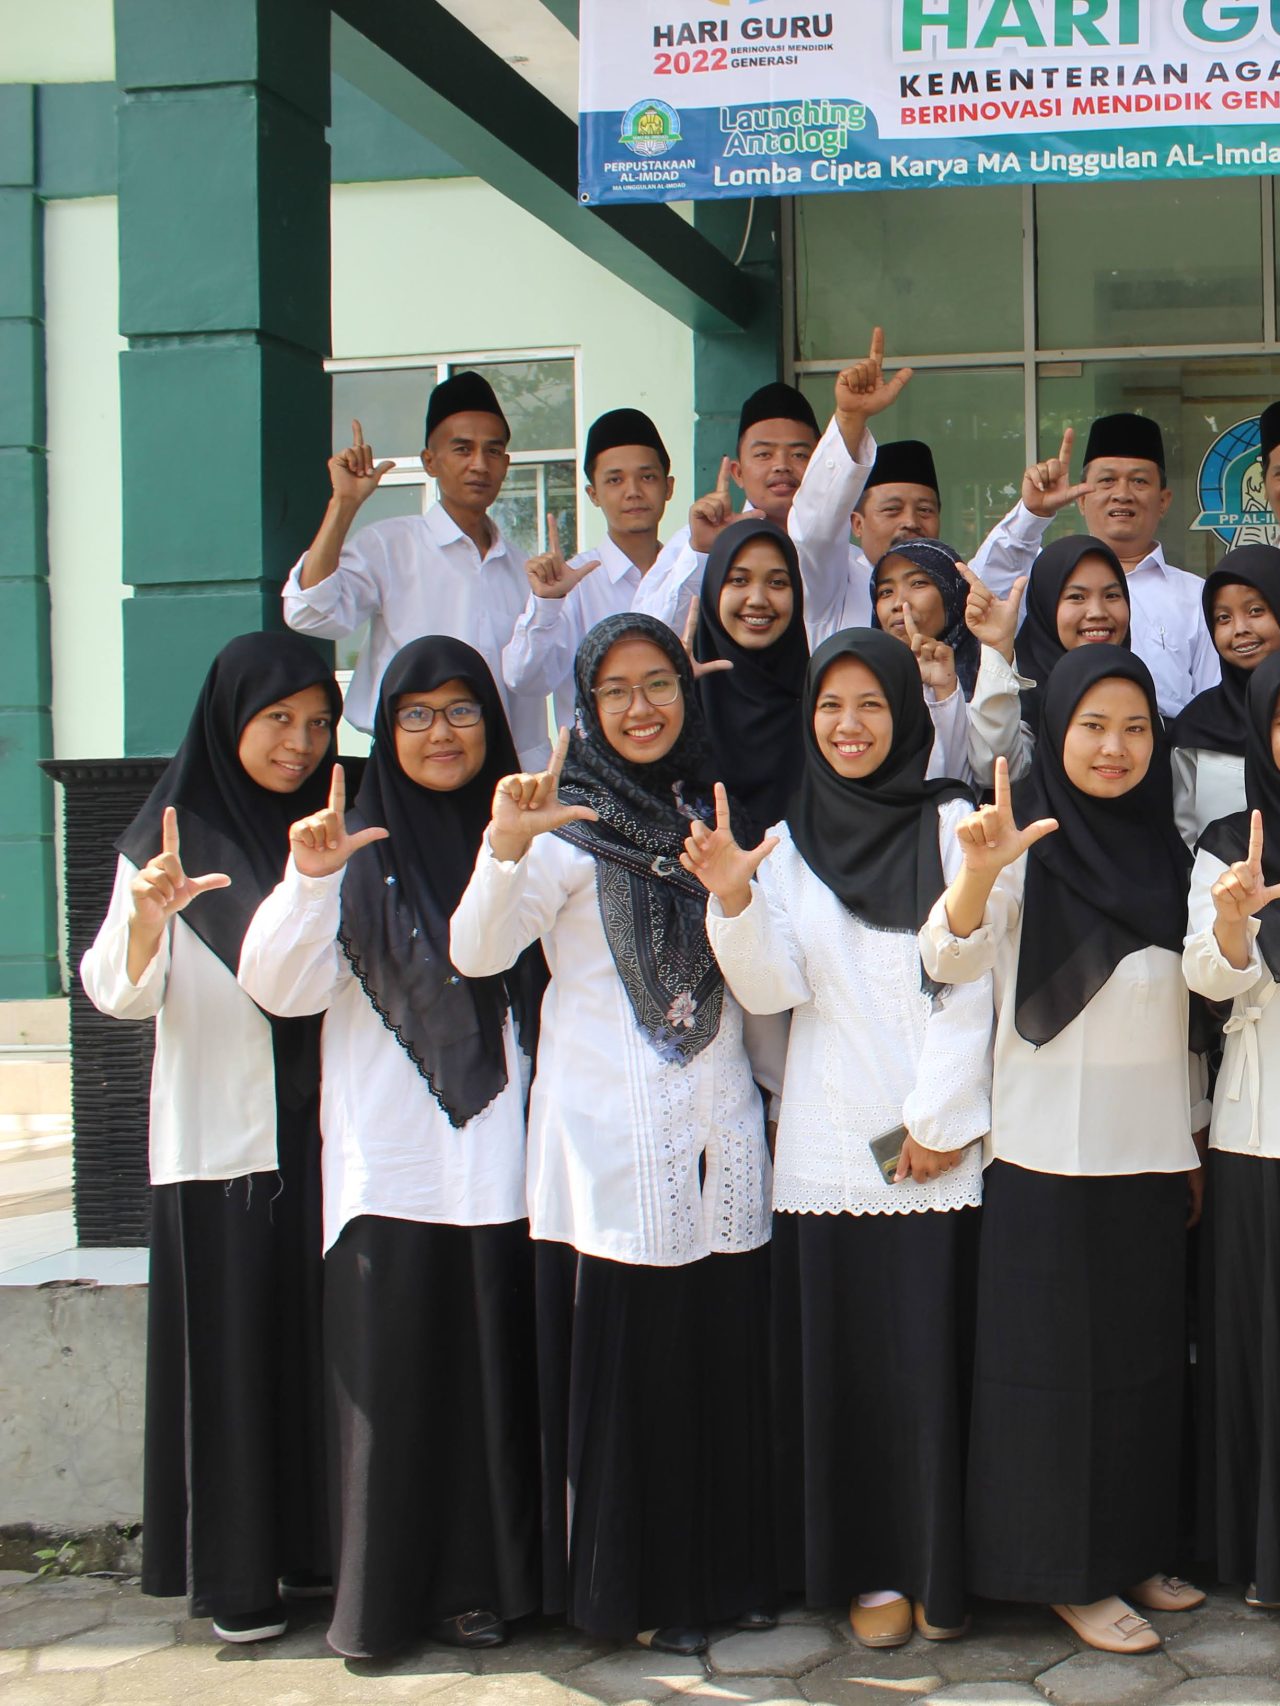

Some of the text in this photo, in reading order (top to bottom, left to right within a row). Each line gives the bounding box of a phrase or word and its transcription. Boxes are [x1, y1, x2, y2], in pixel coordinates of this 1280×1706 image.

[652, 13, 833, 48] HARI GURU
[902, 0, 1139, 52] HARI
[653, 47, 728, 75] 2022
[730, 43, 834, 55] BERINOVASI MENDIDIK
[730, 55, 799, 69] GENERASI
[899, 63, 1189, 98] KEMENTERIAN
[719, 99, 866, 133] Launching
[900, 98, 1062, 125] BERINOVASI
[1071, 91, 1212, 116] MENDIDIK
[722, 125, 848, 158] Antologi
[604, 159, 696, 173] PERPUSTAKAAN
[620, 171, 680, 182] AL-IMDAD
[713, 162, 802, 187] Lomba
[810, 158, 882, 187] Cipta
[890, 155, 968, 182] Karya
[977, 152, 1022, 174] MA
[1030, 145, 1157, 176] Unggulan
[1219, 514, 1239, 525] PP
